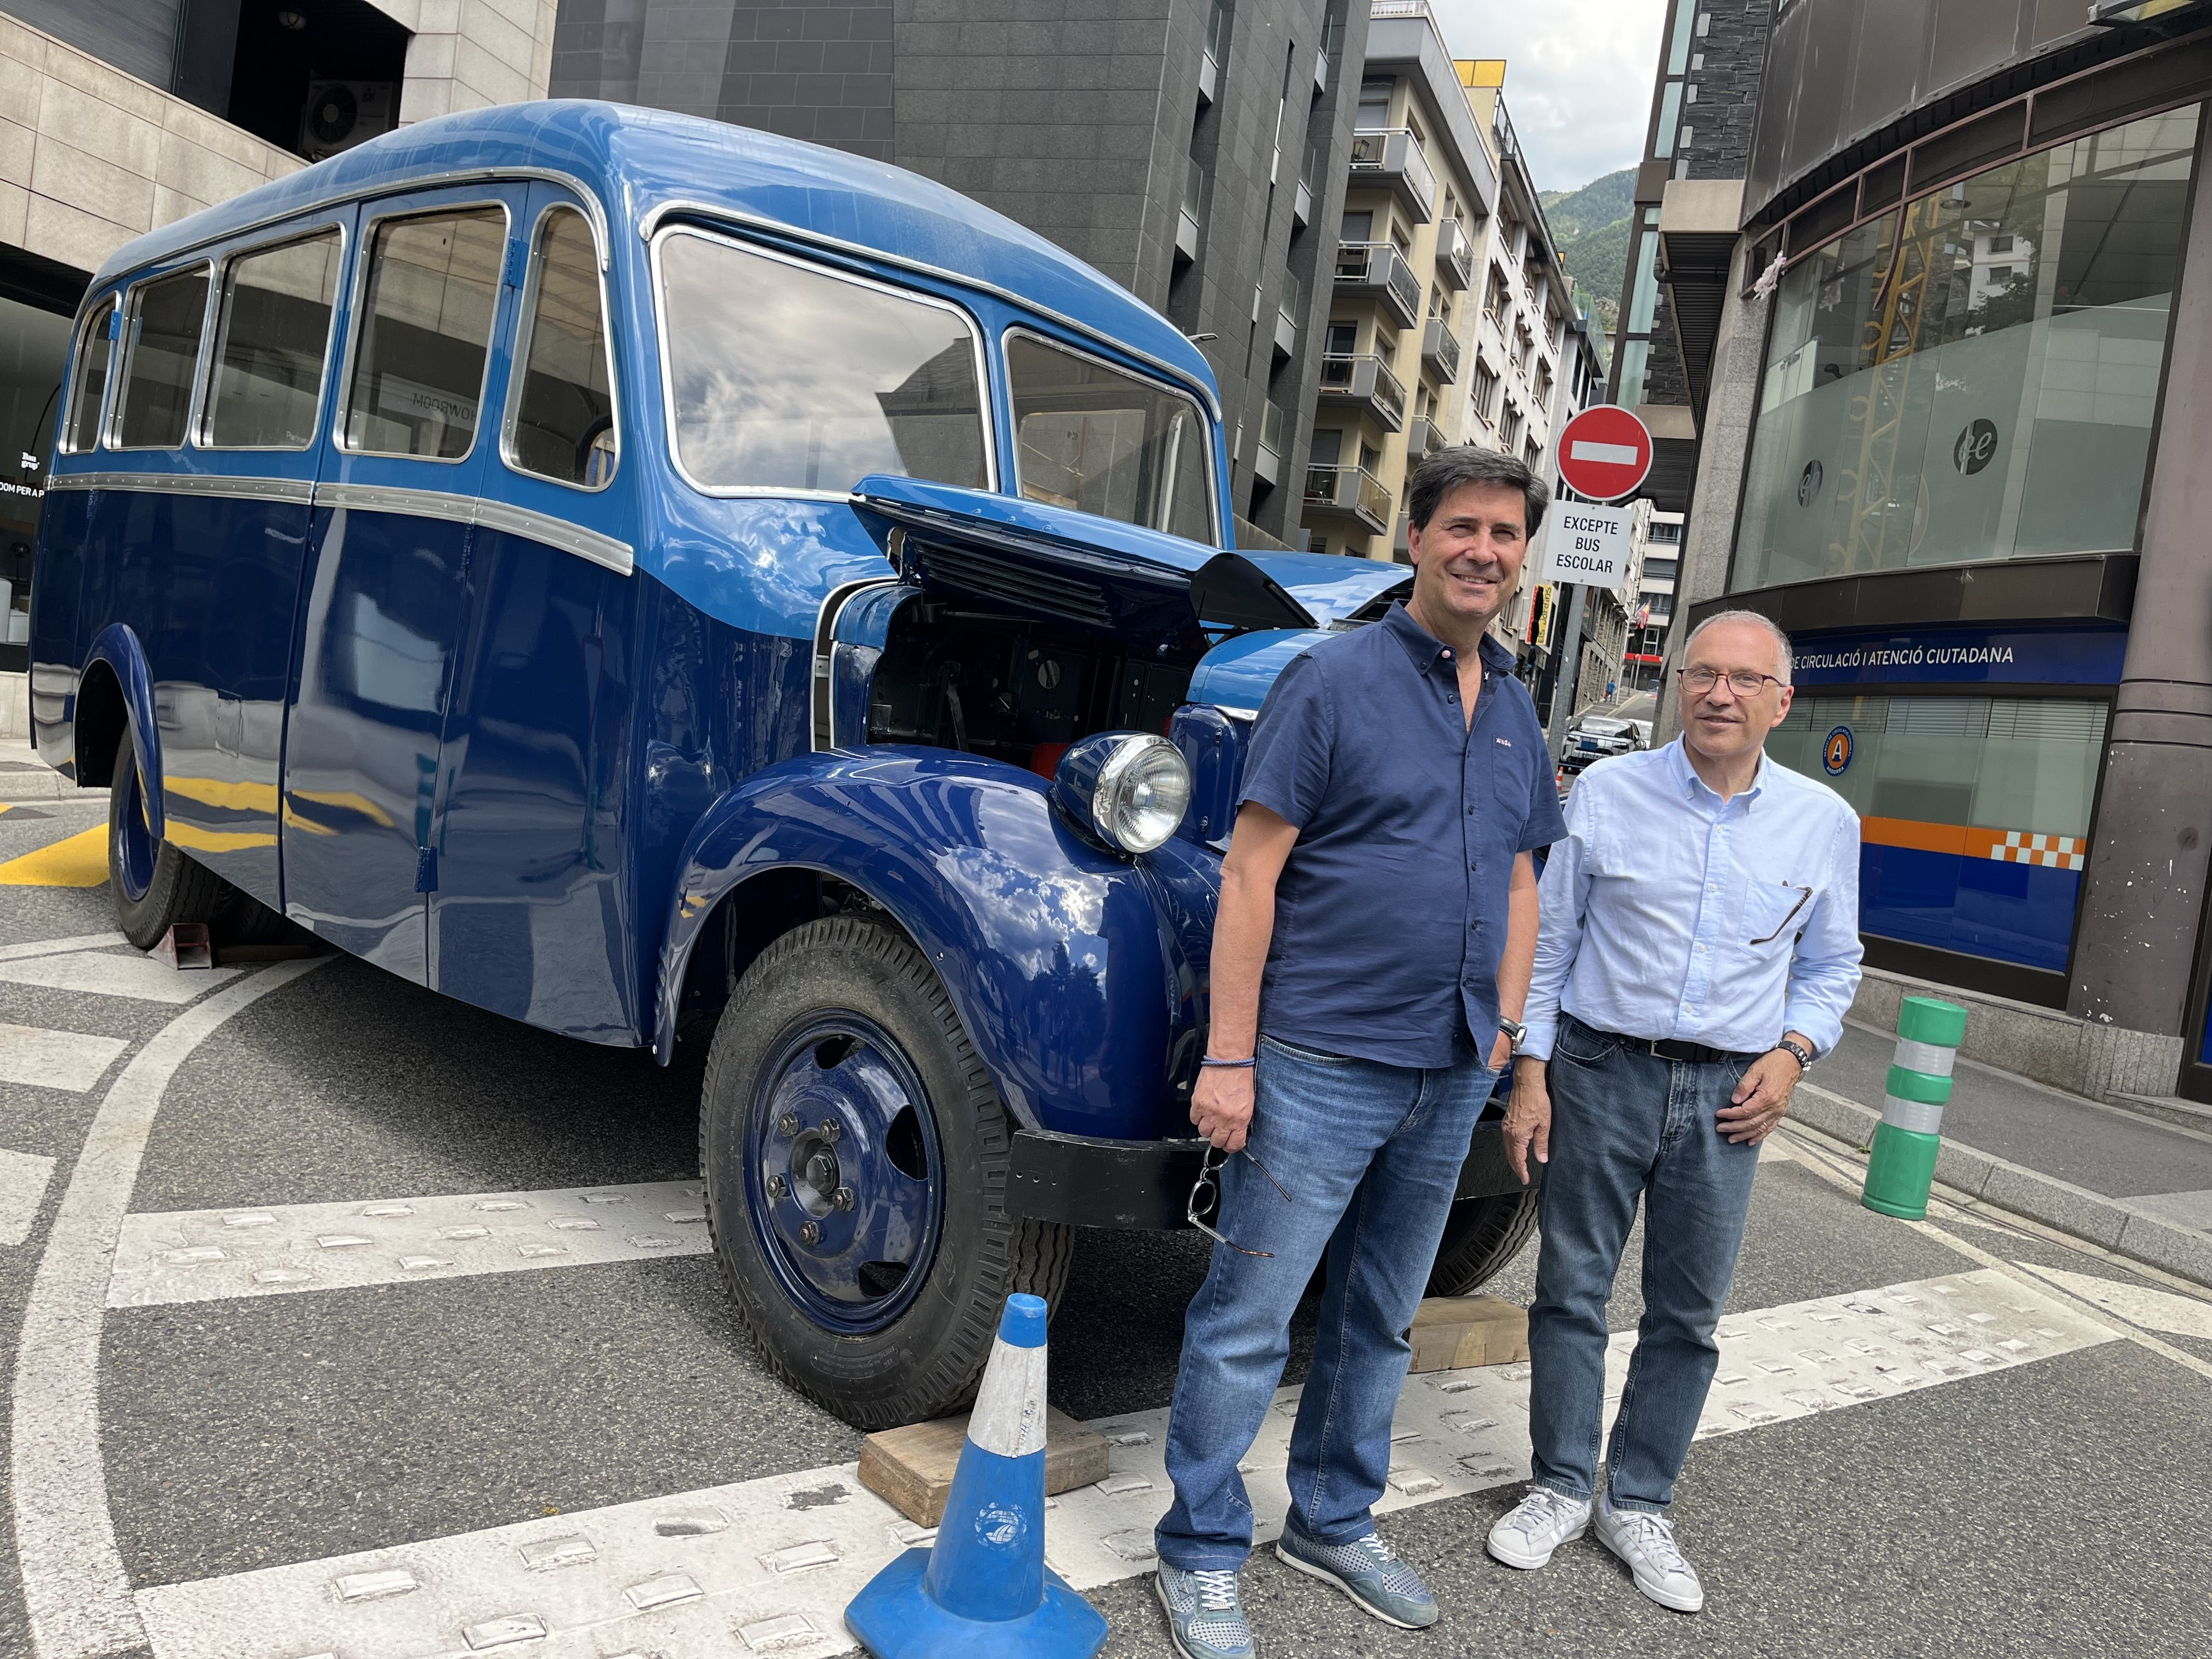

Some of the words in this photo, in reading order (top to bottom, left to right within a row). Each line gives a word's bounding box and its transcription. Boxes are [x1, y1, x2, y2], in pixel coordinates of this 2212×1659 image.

[16, 485, 31, 496] PER
[32, 488, 37, 498] A
[1564, 516, 1618, 534] EXCEPTE
[1575, 537, 1600, 552] BUS
[1556, 554, 1613, 574] ESCOLAR
[1539, 587, 1551, 625] Jardins
[1801, 648, 1860, 669] CIRCULACIÓ
[1863, 652, 1866, 666] I
[1867, 645, 1922, 666] ATENCIÓ
[1926, 647, 2014, 664] CIUTADANA
[1832, 740, 1842, 760] A
